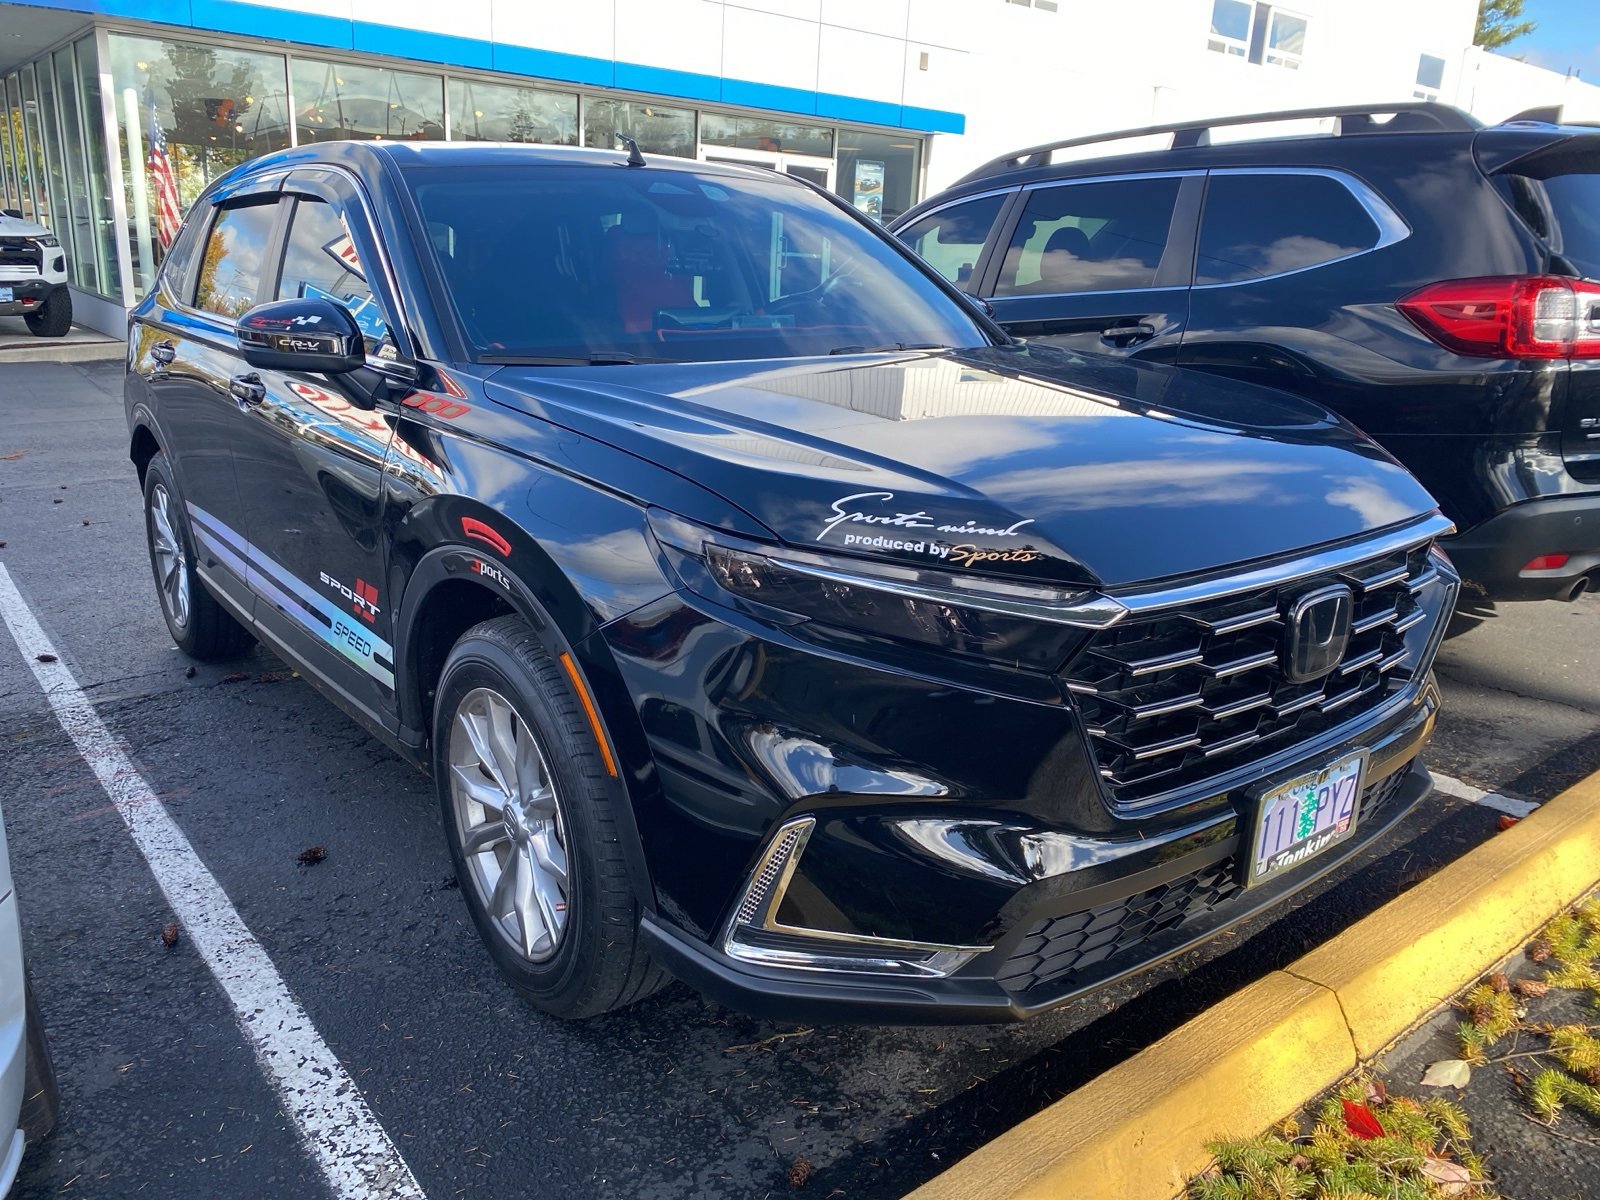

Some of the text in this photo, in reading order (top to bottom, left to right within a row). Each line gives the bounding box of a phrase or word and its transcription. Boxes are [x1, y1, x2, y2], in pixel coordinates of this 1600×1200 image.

[279, 339, 320, 349] CR-V
[816, 492, 935, 542] Sports
[844, 533, 1039, 568] produced by Sports
[319, 570, 381, 616] SPORT
[333, 621, 372, 658] SPEED
[1261, 772, 1358, 860] 111 PYZ
[1275, 834, 1333, 867] Tonkin
